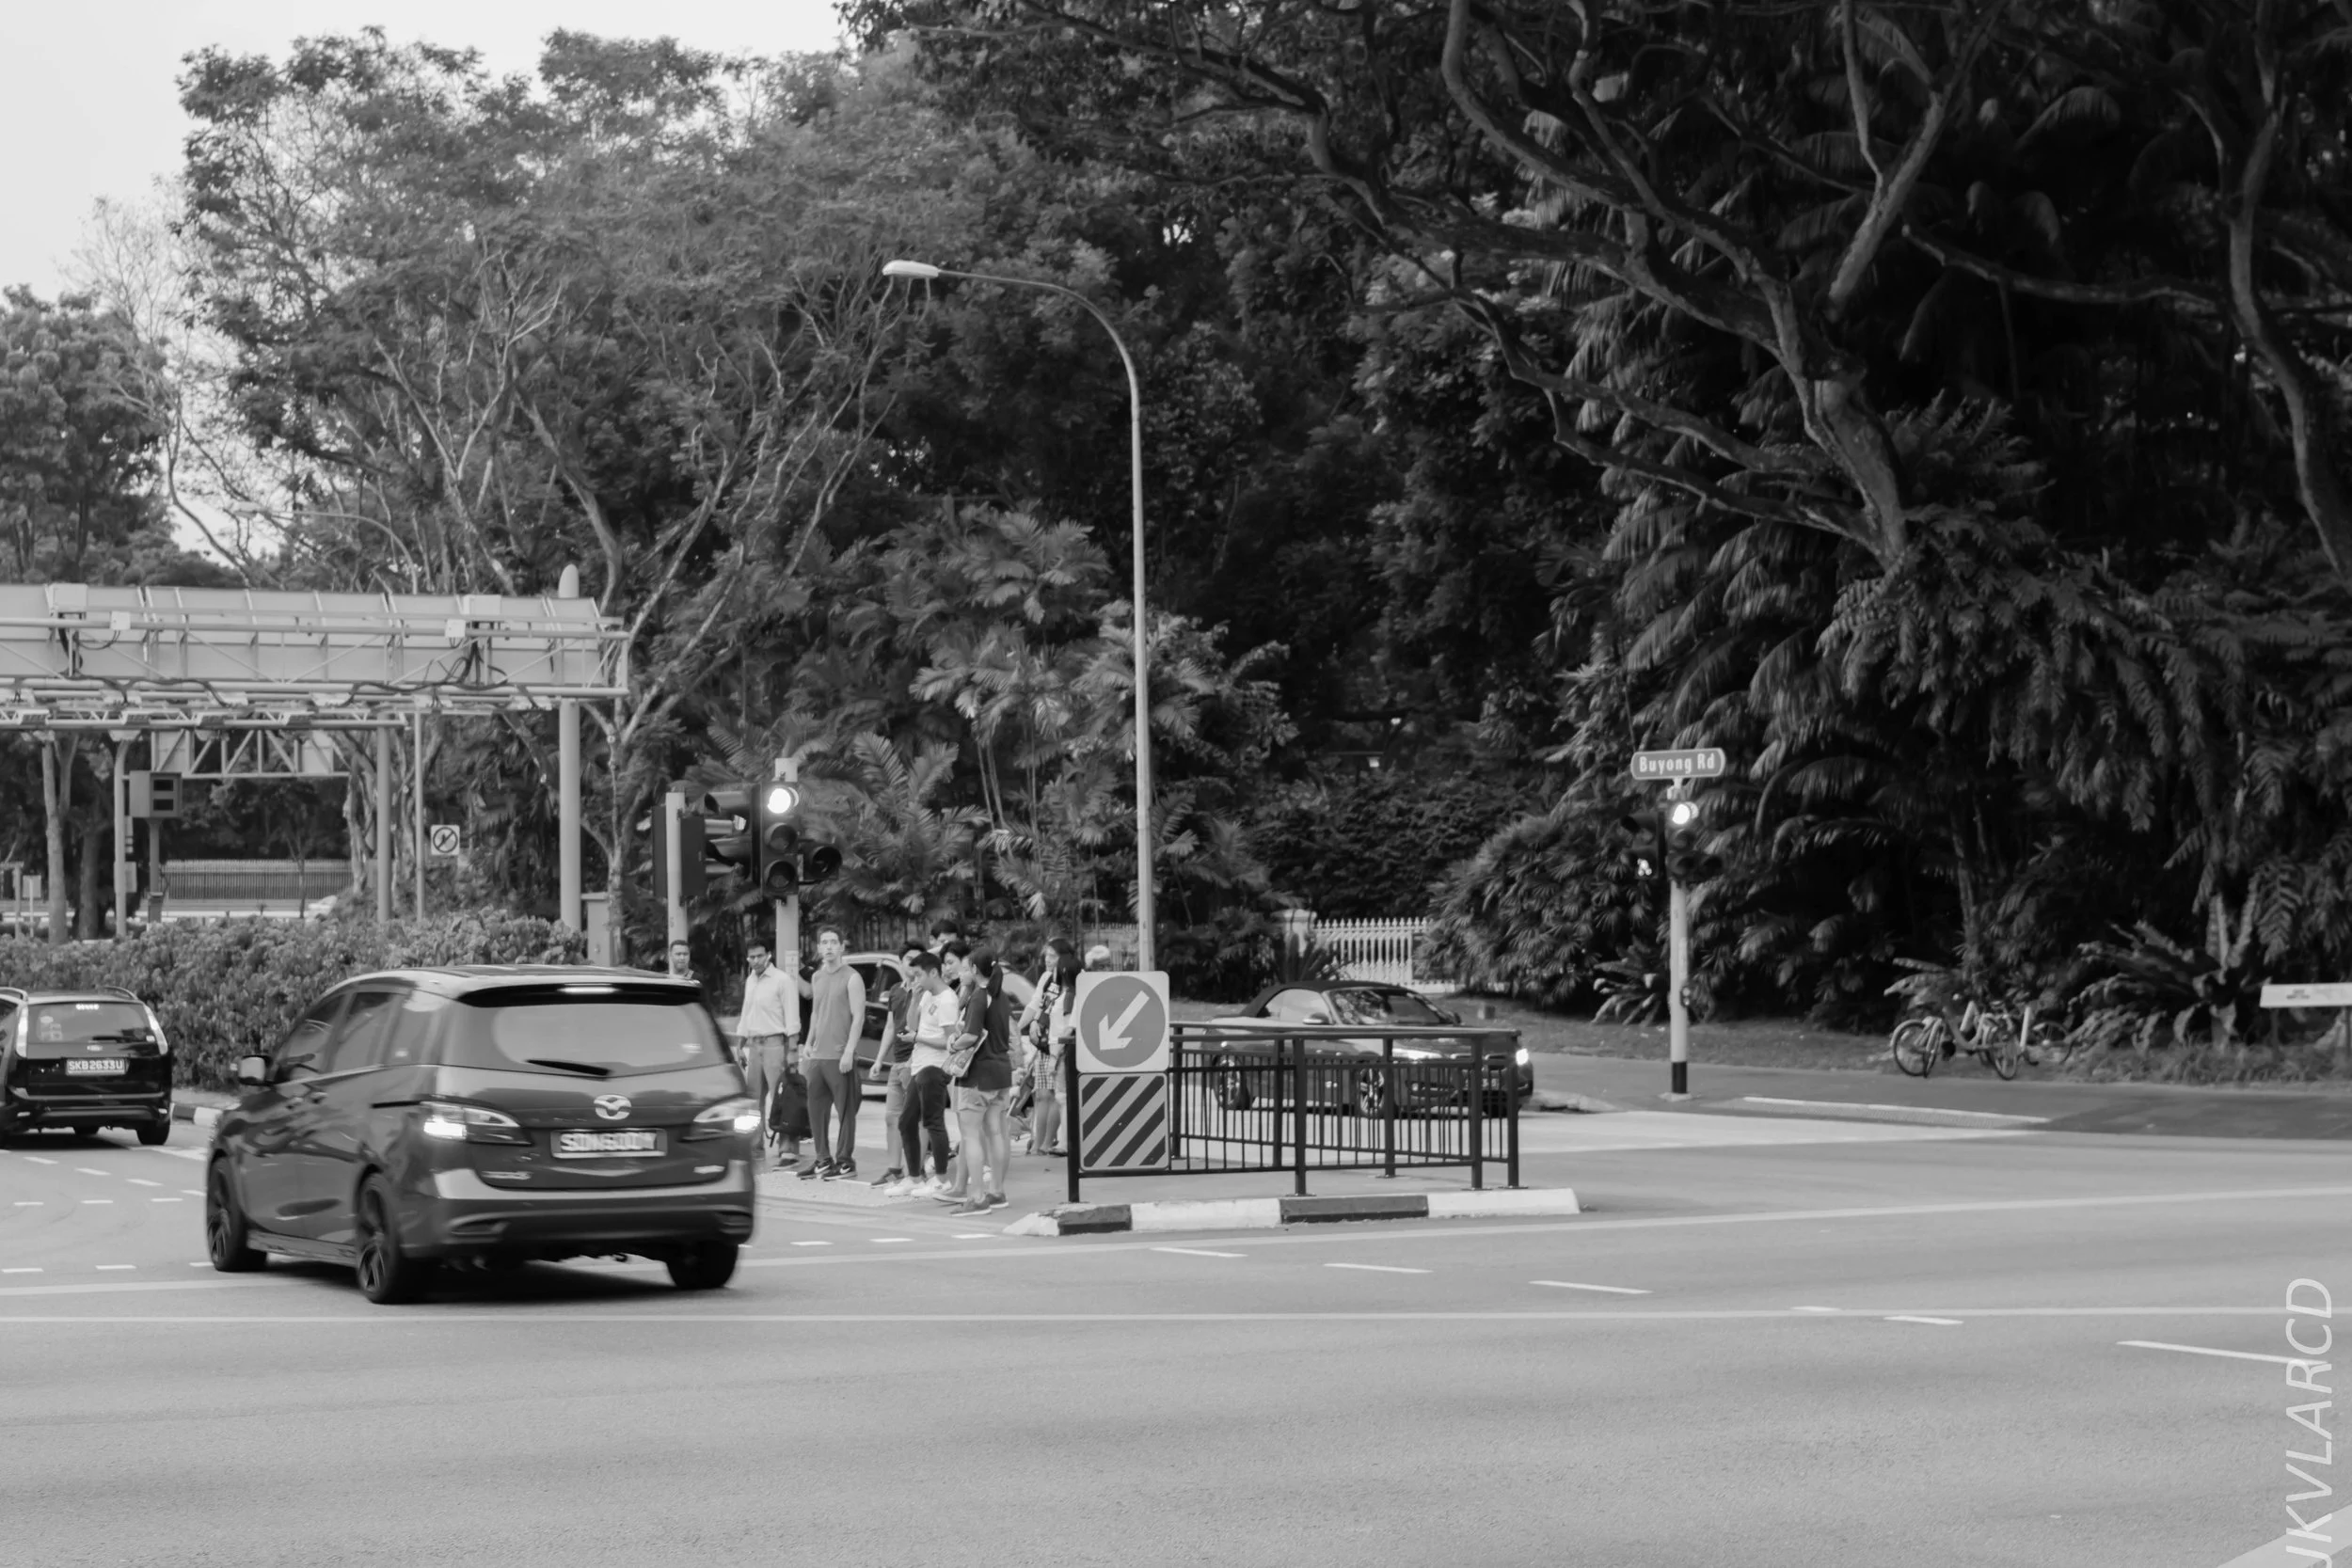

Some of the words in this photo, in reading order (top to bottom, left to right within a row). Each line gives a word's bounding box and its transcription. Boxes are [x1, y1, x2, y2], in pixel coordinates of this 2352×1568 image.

[1639, 755, 1692, 775] Buyong
[1697, 752, 1715, 770] Rd
[69, 1060, 123, 1070] SKB2633U
